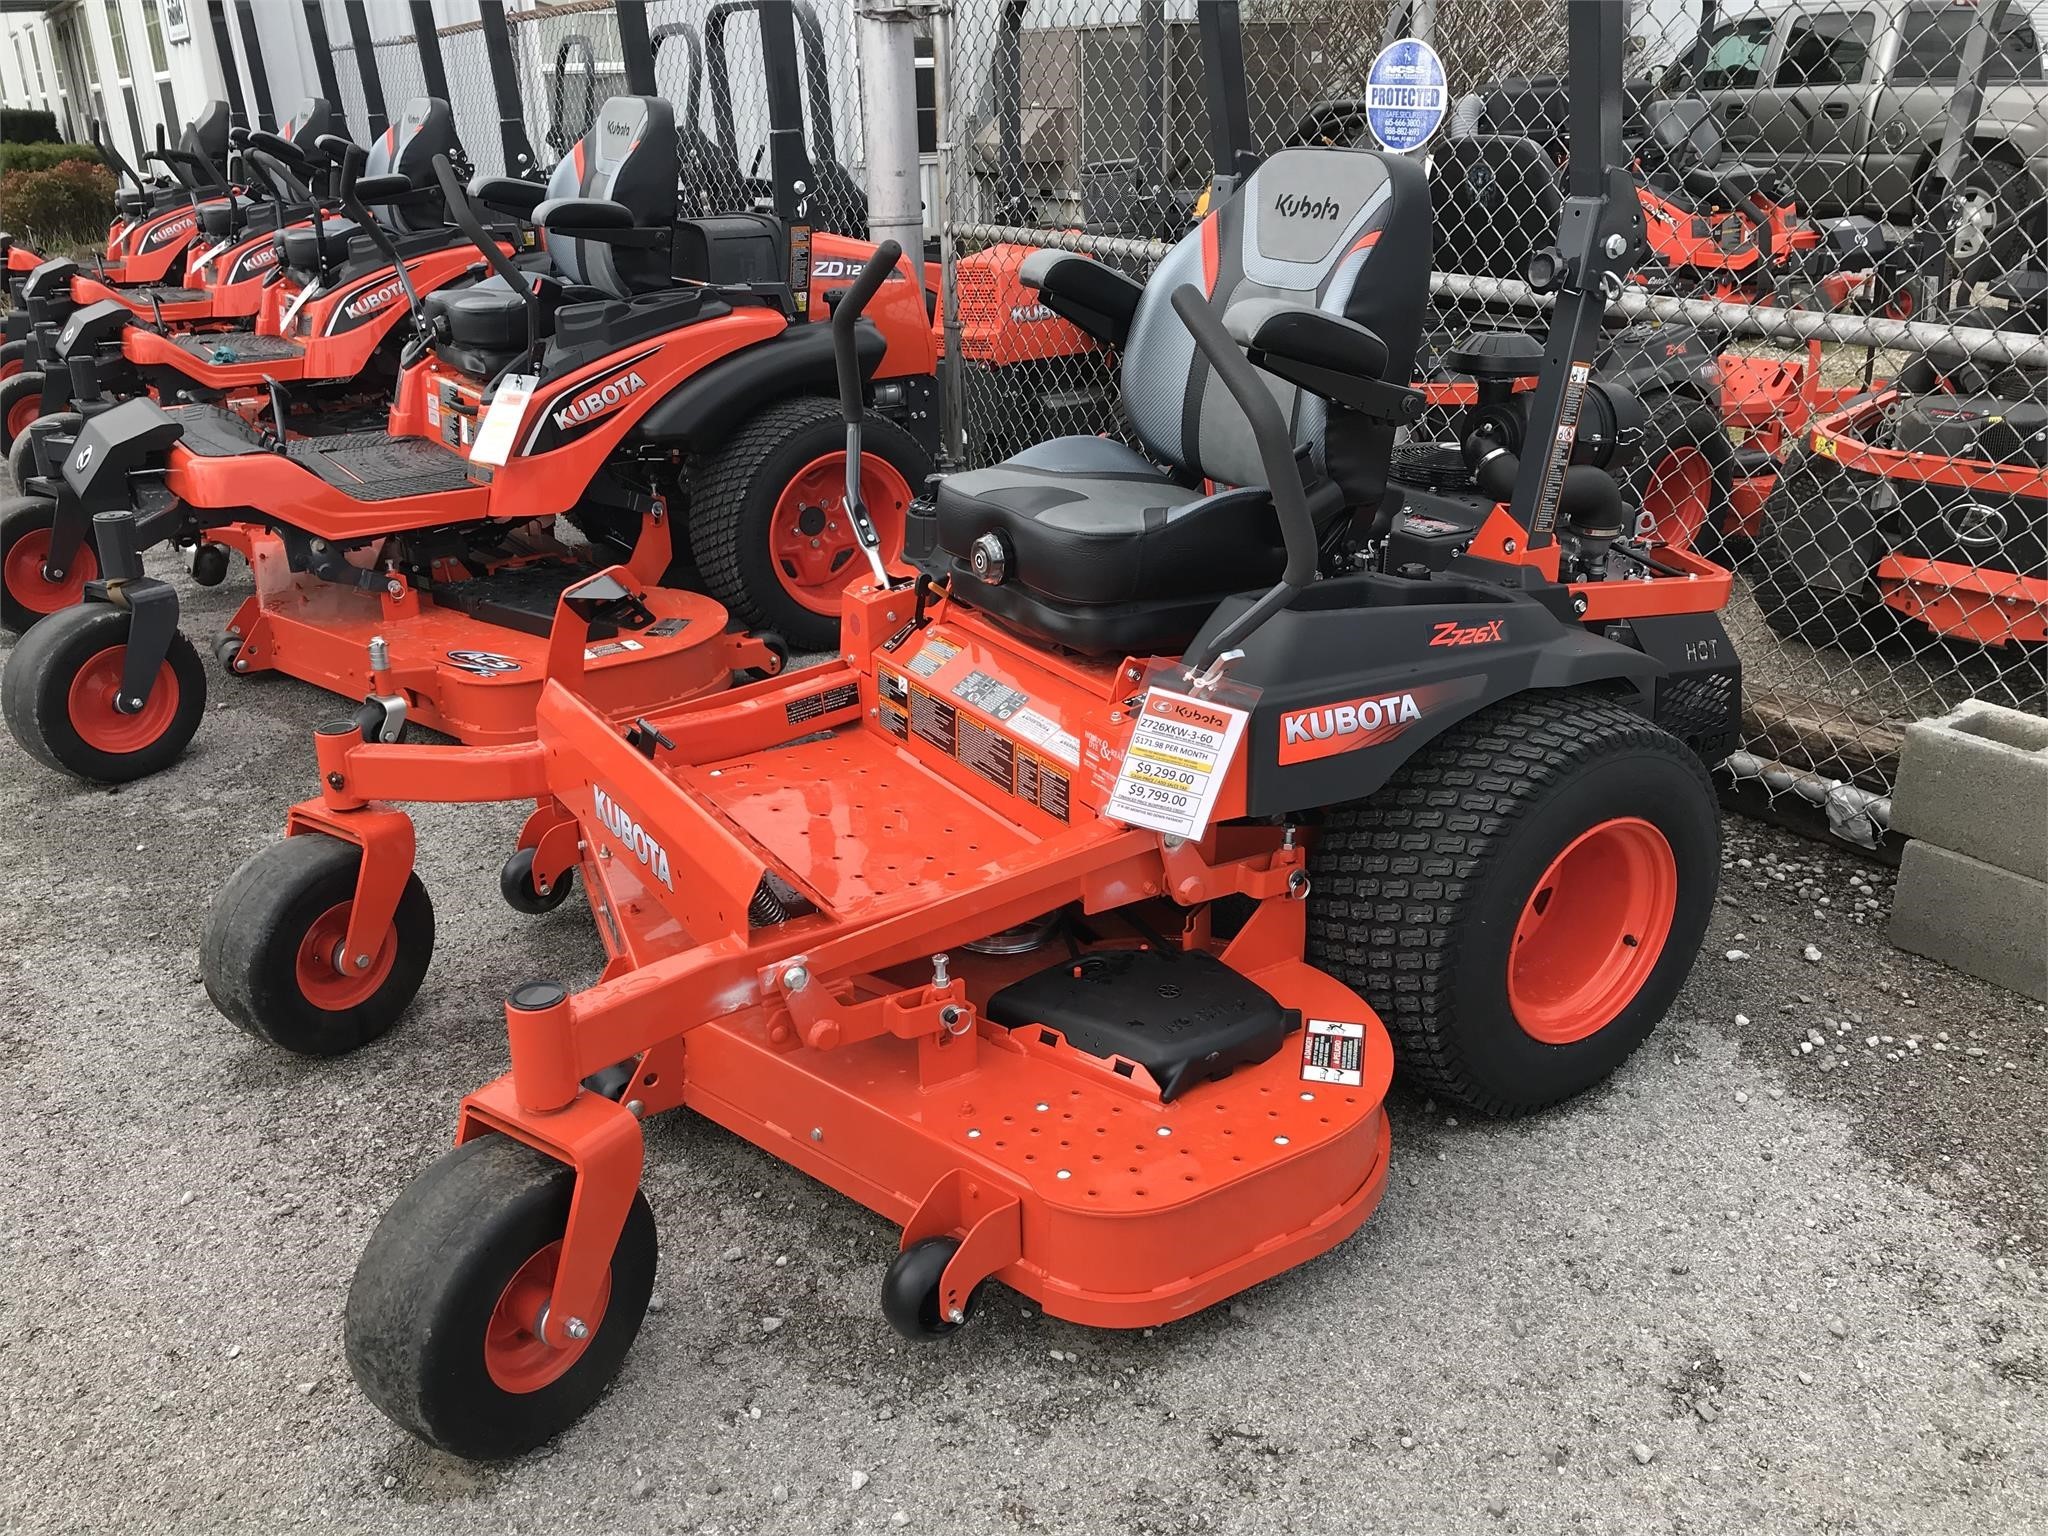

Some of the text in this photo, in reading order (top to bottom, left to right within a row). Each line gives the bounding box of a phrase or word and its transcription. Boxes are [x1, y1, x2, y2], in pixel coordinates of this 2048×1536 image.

[1371, 87, 1440, 107] PROTECTED
[1274, 193, 1340, 221] Kubota
[150, 217, 194, 245] KUBOTA
[242, 246, 278, 272] KUBO
[812, 261, 866, 276] ZD 12
[1010, 304, 1058, 322] KUB
[552, 371, 648, 431] KUBOTA
[1429, 619, 1505, 647] Z726X
[456, 653, 519, 669] ACS
[1685, 639, 1718, 662] HOT
[1175, 705, 1223, 727] Kubota
[1284, 693, 1423, 745] KUBOTA
[1141, 718, 1213, 744] Z726XKW-3-60
[1135, 736, 1164, 749] $171.98
[1164, 743, 1179, 753] PER
[1179, 747, 1209, 760] MONTH
[1135, 761, 1194, 785] $9,299.00
[1128, 783, 1187, 807] $9,799.00
[593, 783, 675, 894] KUBOTA
